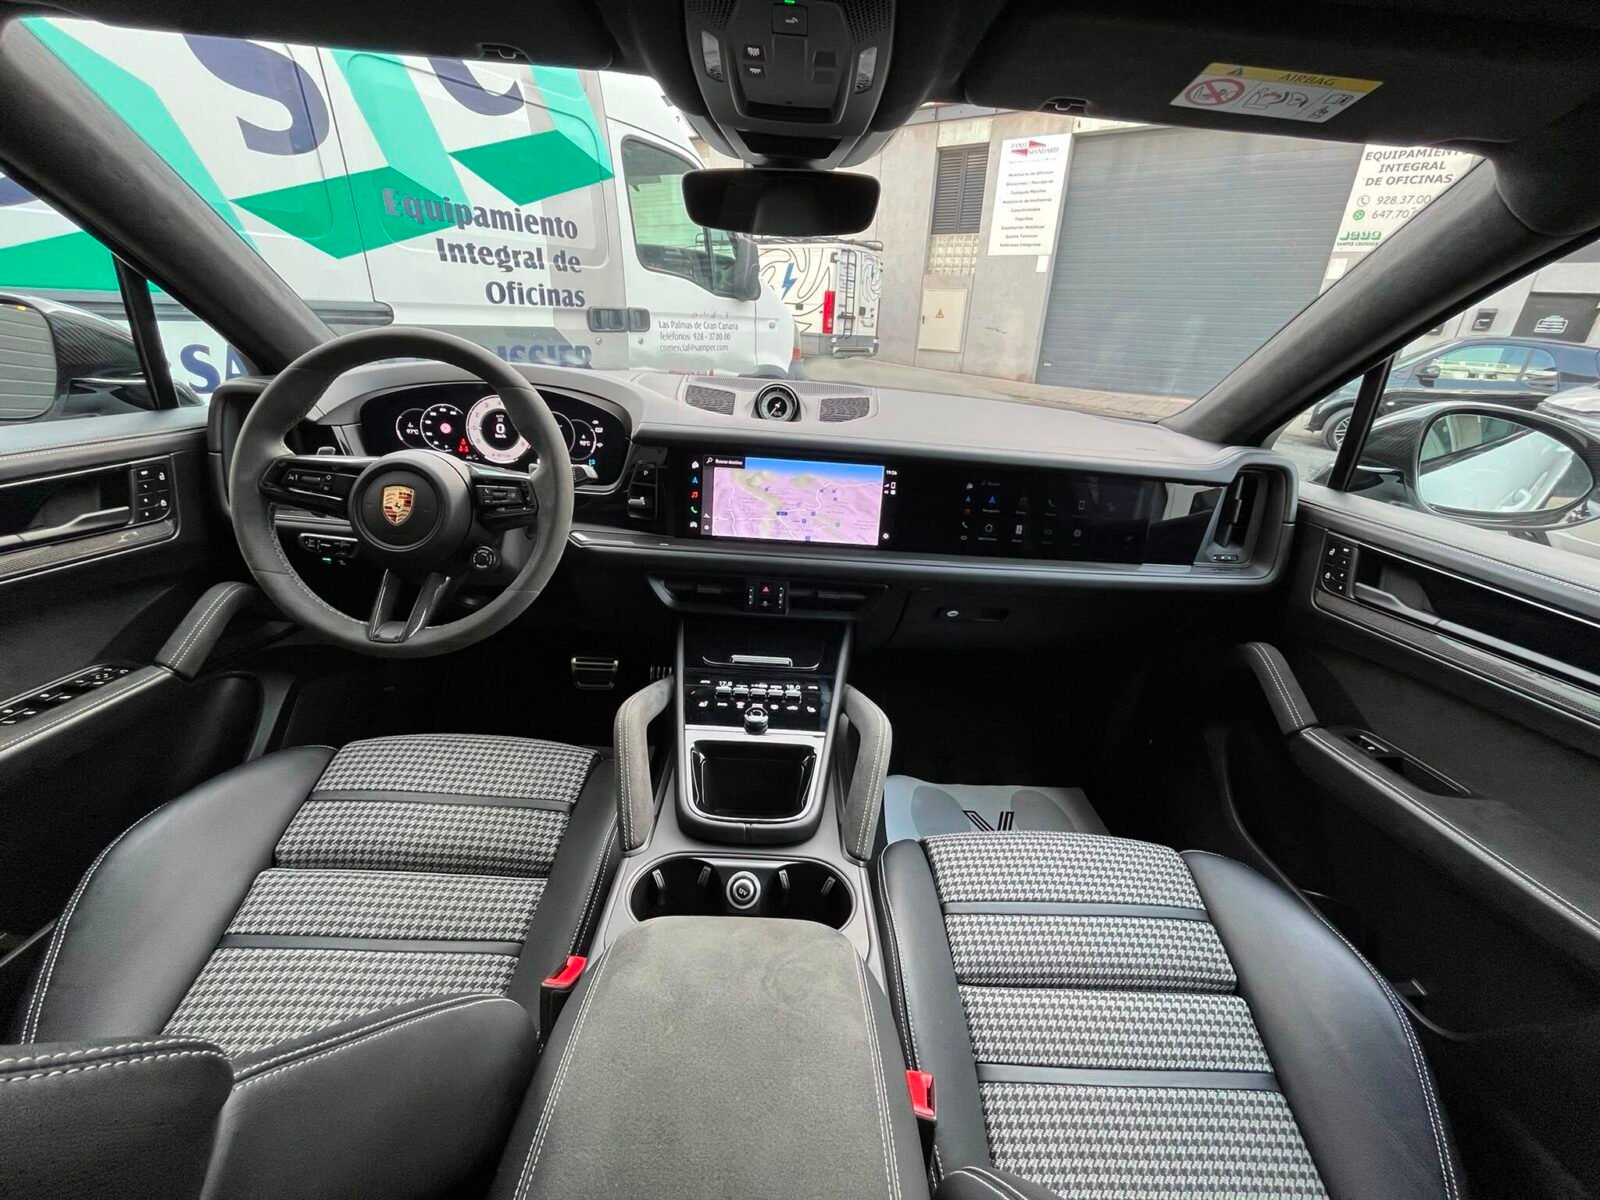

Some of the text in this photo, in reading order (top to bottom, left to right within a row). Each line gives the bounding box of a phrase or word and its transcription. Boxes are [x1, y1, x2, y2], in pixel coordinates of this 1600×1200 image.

[1278, 73, 1336, 86] AIRBAG
[1378, 161, 1447, 173] INTEGRAL
[1365, 174, 1454, 187] DE OFICINAS
[382, 188, 579, 240] Equipamiento
[436, 238, 582, 273] Integral de
[485, 281, 586, 308] Oficinas
[658, 320, 739, 332] Las Palmas de Gran Canaria
[693, 332, 704, 341] 928
